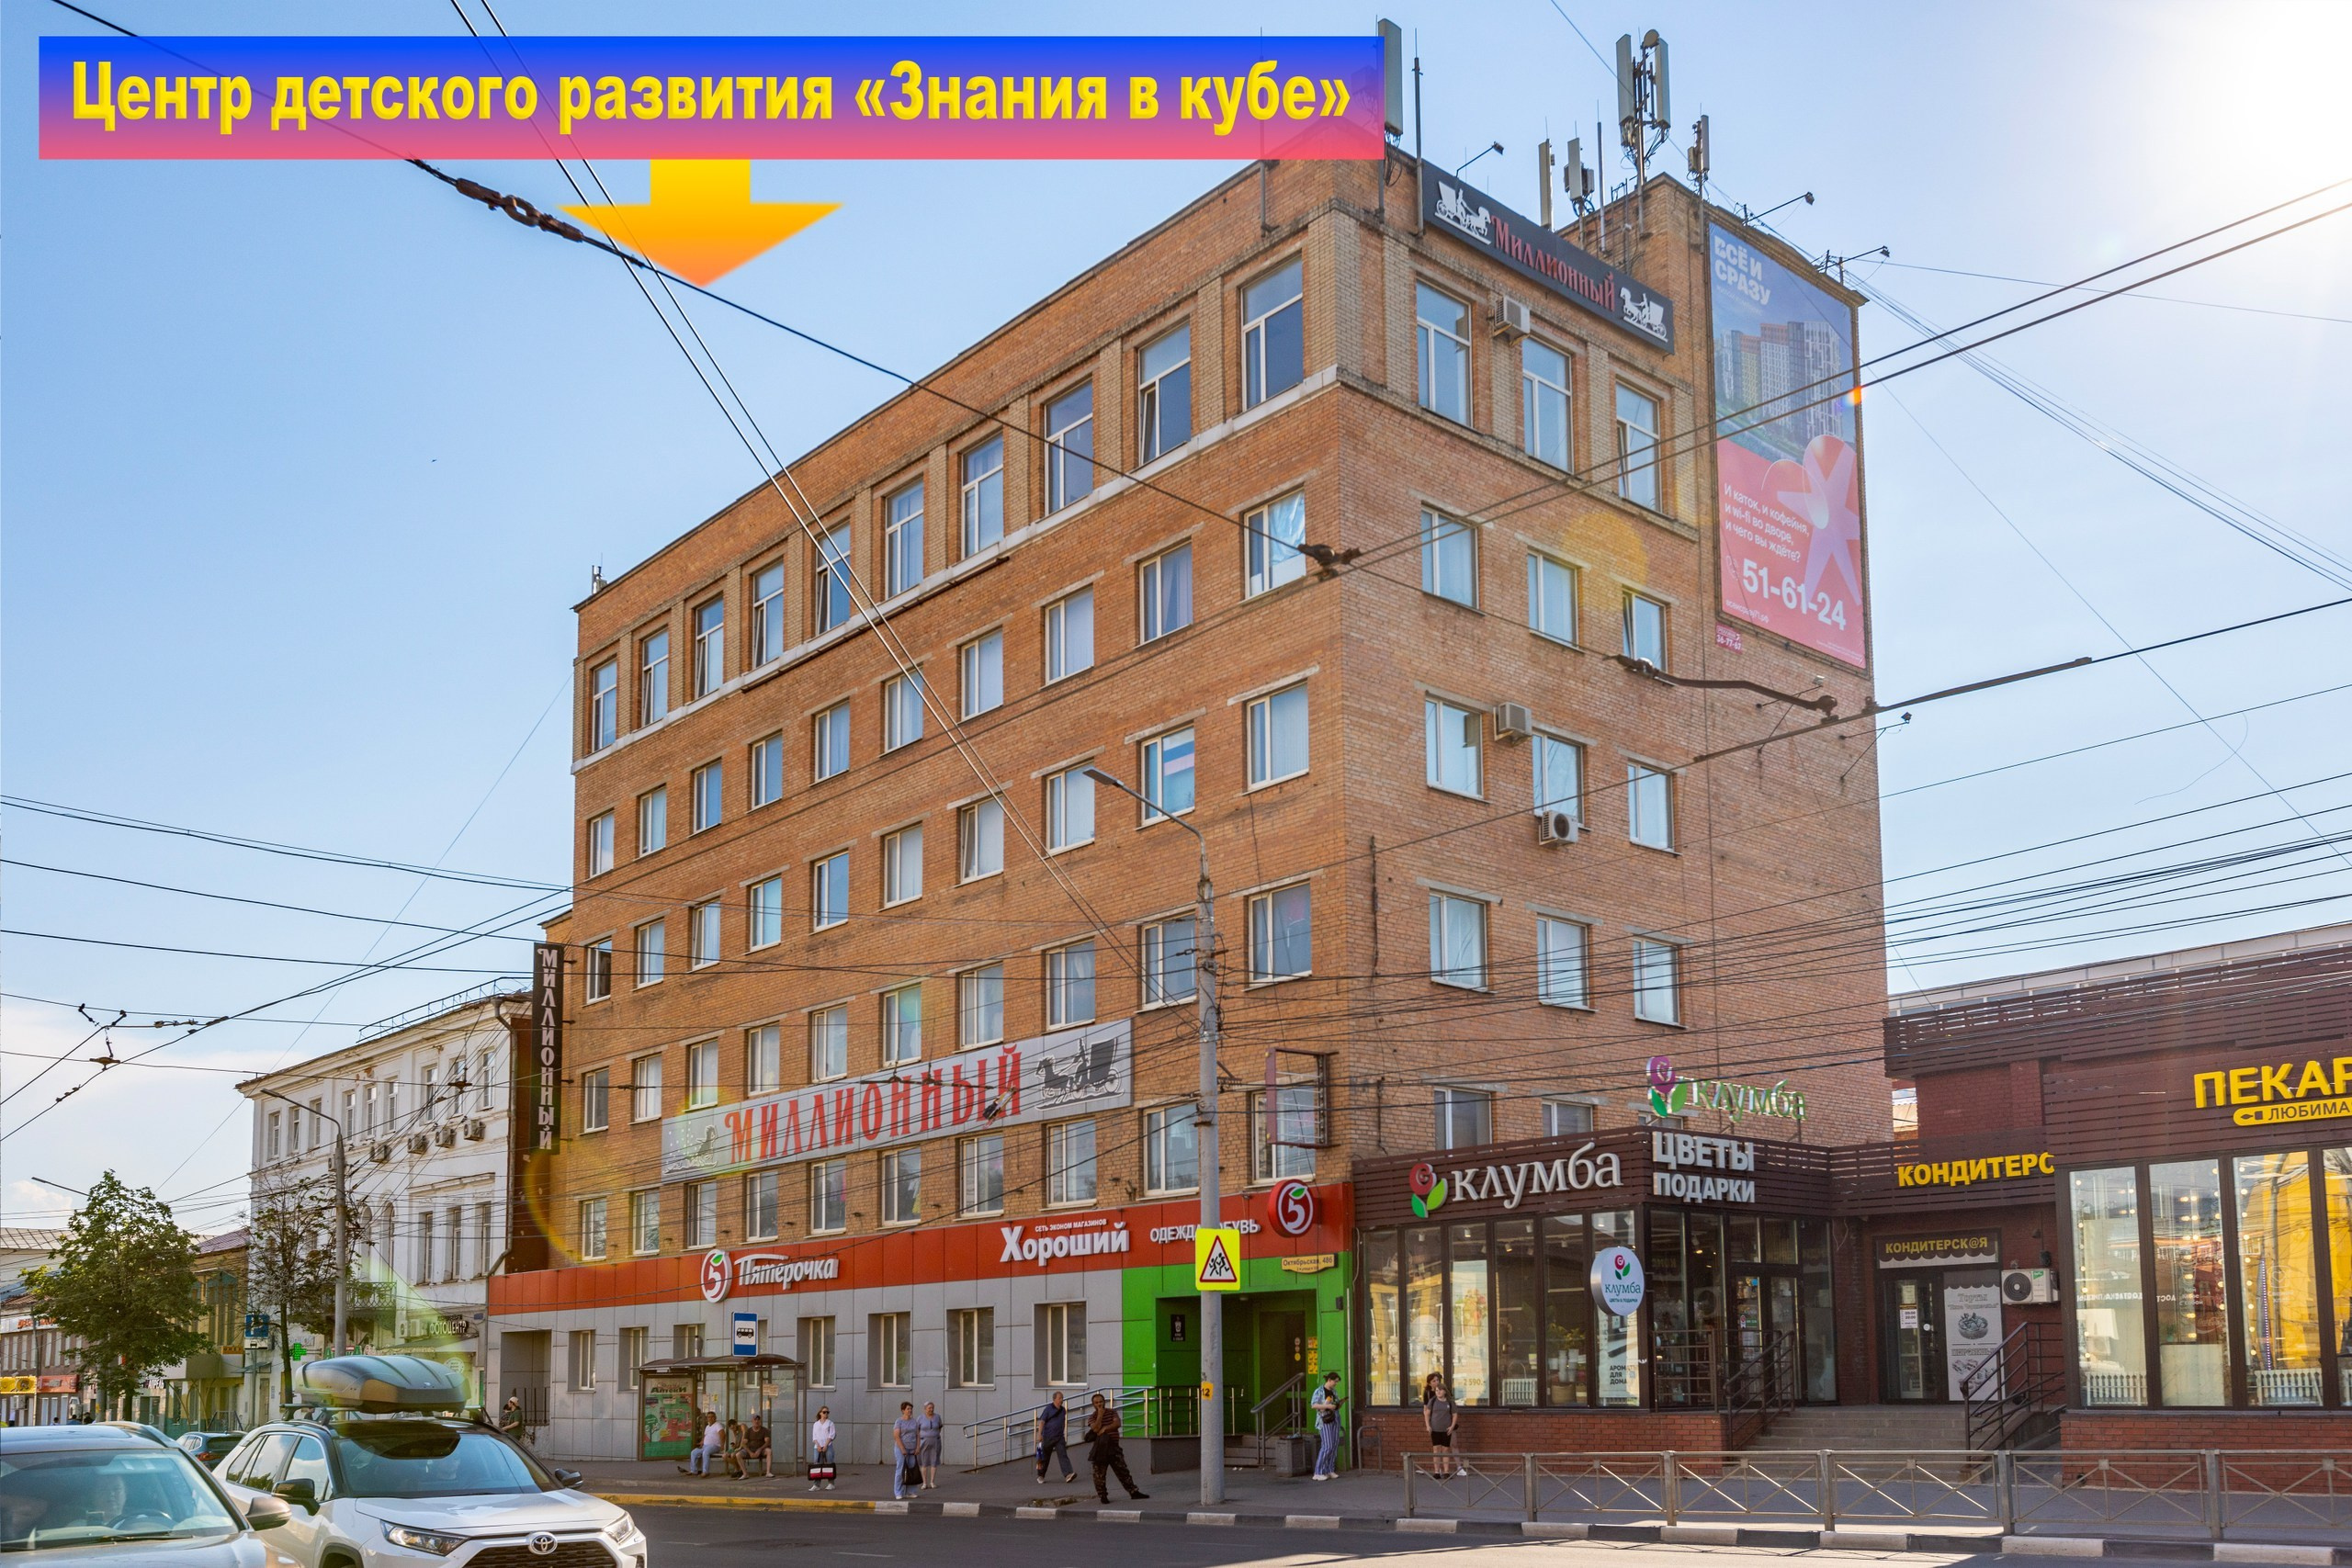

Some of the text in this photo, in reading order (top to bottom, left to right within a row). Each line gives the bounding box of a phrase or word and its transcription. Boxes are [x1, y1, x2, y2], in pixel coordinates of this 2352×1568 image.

[1714, 259, 1771, 306] СРАЗУ
[1750, 254, 1762, 280] И
[1724, 482, 1732, 497] И
[1733, 490, 1761, 514] каток,
[1770, 508, 1810, 537] кофейня,
[1753, 515, 1764, 530] во
[1733, 523, 1753, 542] чего
[1754, 534, 1767, 548] вы
[1742, 558, 1847, 631] 51-61-24
[2193, 1056, 2352, 1109] ПЕКАР
[724, 1043, 1023, 1165] МИЛЛИОННЫЙ
[2268, 1100, 2352, 1121] ЛЮБИМА
[1653, 1131, 1755, 1171] ЦВЕТЫ
[1451, 1142, 1623, 1209] клумба
[1897, 1151, 2054, 1187] КОНДИТЕРС
[1653, 1171, 1755, 1203] ПОДАРКИ
[1035, 1218, 1107, 1233] СЕТЬ ЭКОНОМ МАГАЗИНОВ
[1220, 1219, 1261, 1235] БУВЬ
[1000, 1221, 1130, 1267] Хороший
[1885, 1236, 1989, 1255] КОНДИТЕРСК@Я
[1604, 1281, 1642, 1296] клумба
